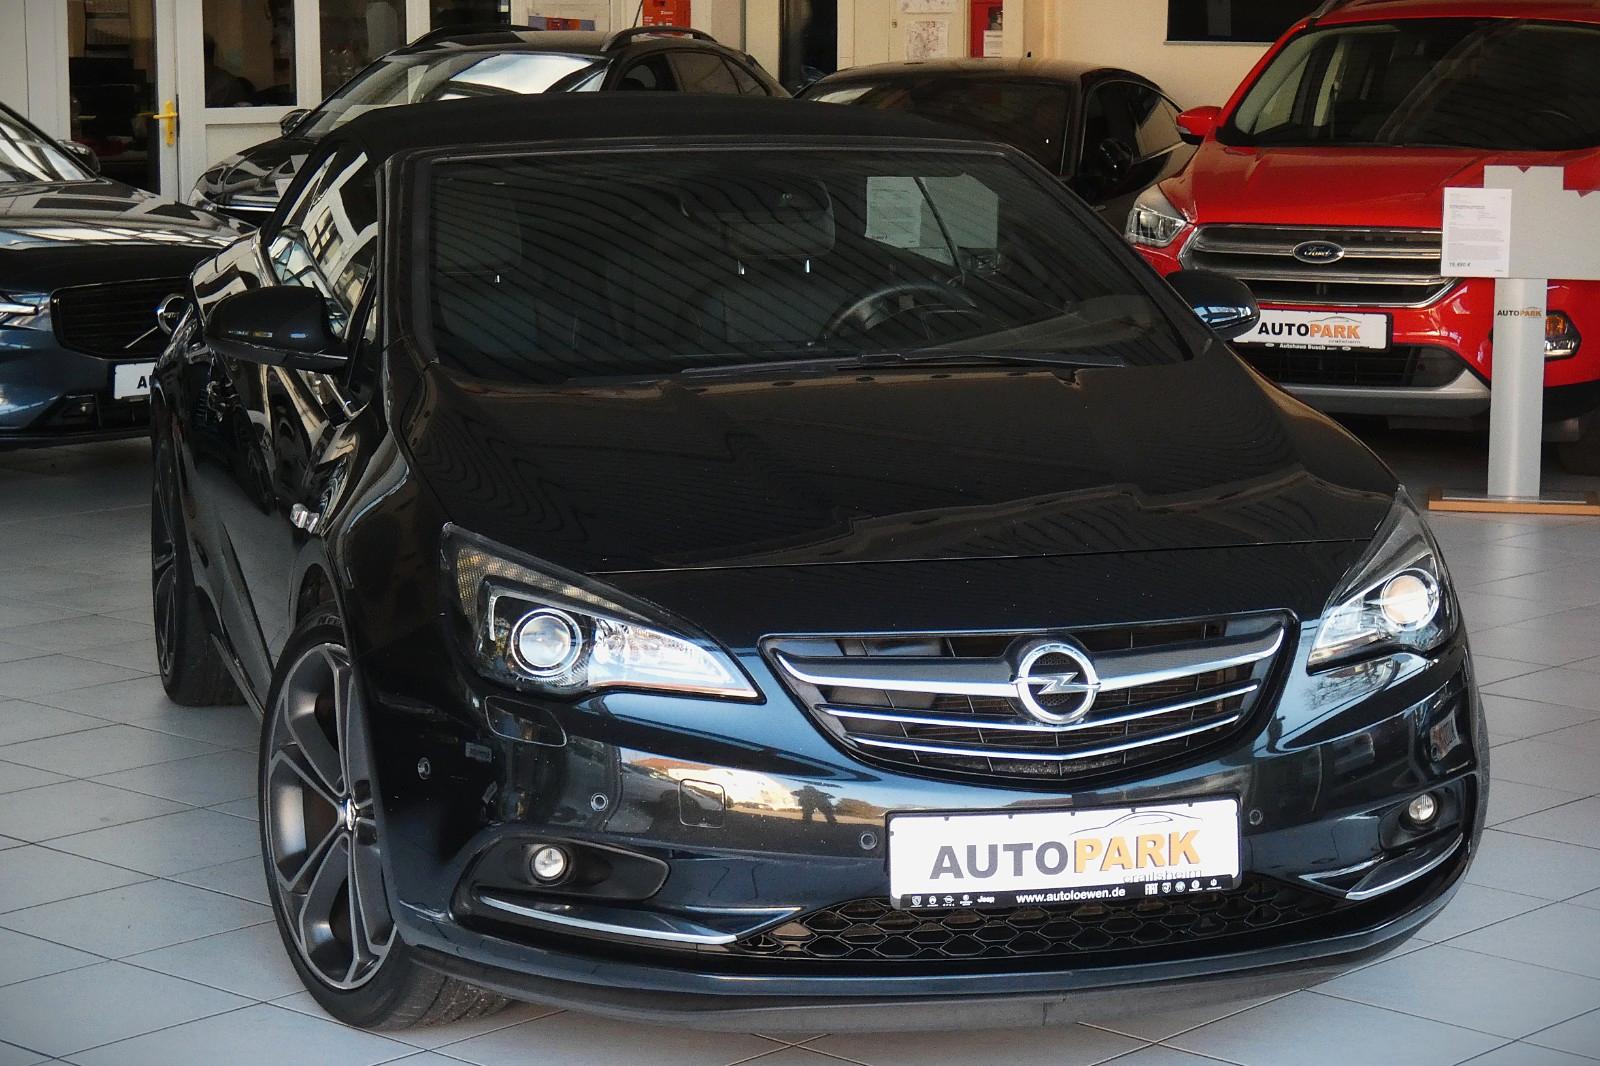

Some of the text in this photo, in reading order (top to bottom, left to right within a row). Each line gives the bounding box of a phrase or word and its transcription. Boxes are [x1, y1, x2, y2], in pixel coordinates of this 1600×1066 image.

[1497, 309, 1542, 317] AUTOPARK
[1258, 321, 1360, 339] AUTOPARK
[930, 829, 1201, 880] AUTOPARK
[1122, 869, 1202, 883] crailsheim
[1016, 886, 1126, 904] www.autoloewen.de
[1145, 882, 1159, 896] FIAT
[977, 896, 996, 904] Jeep
